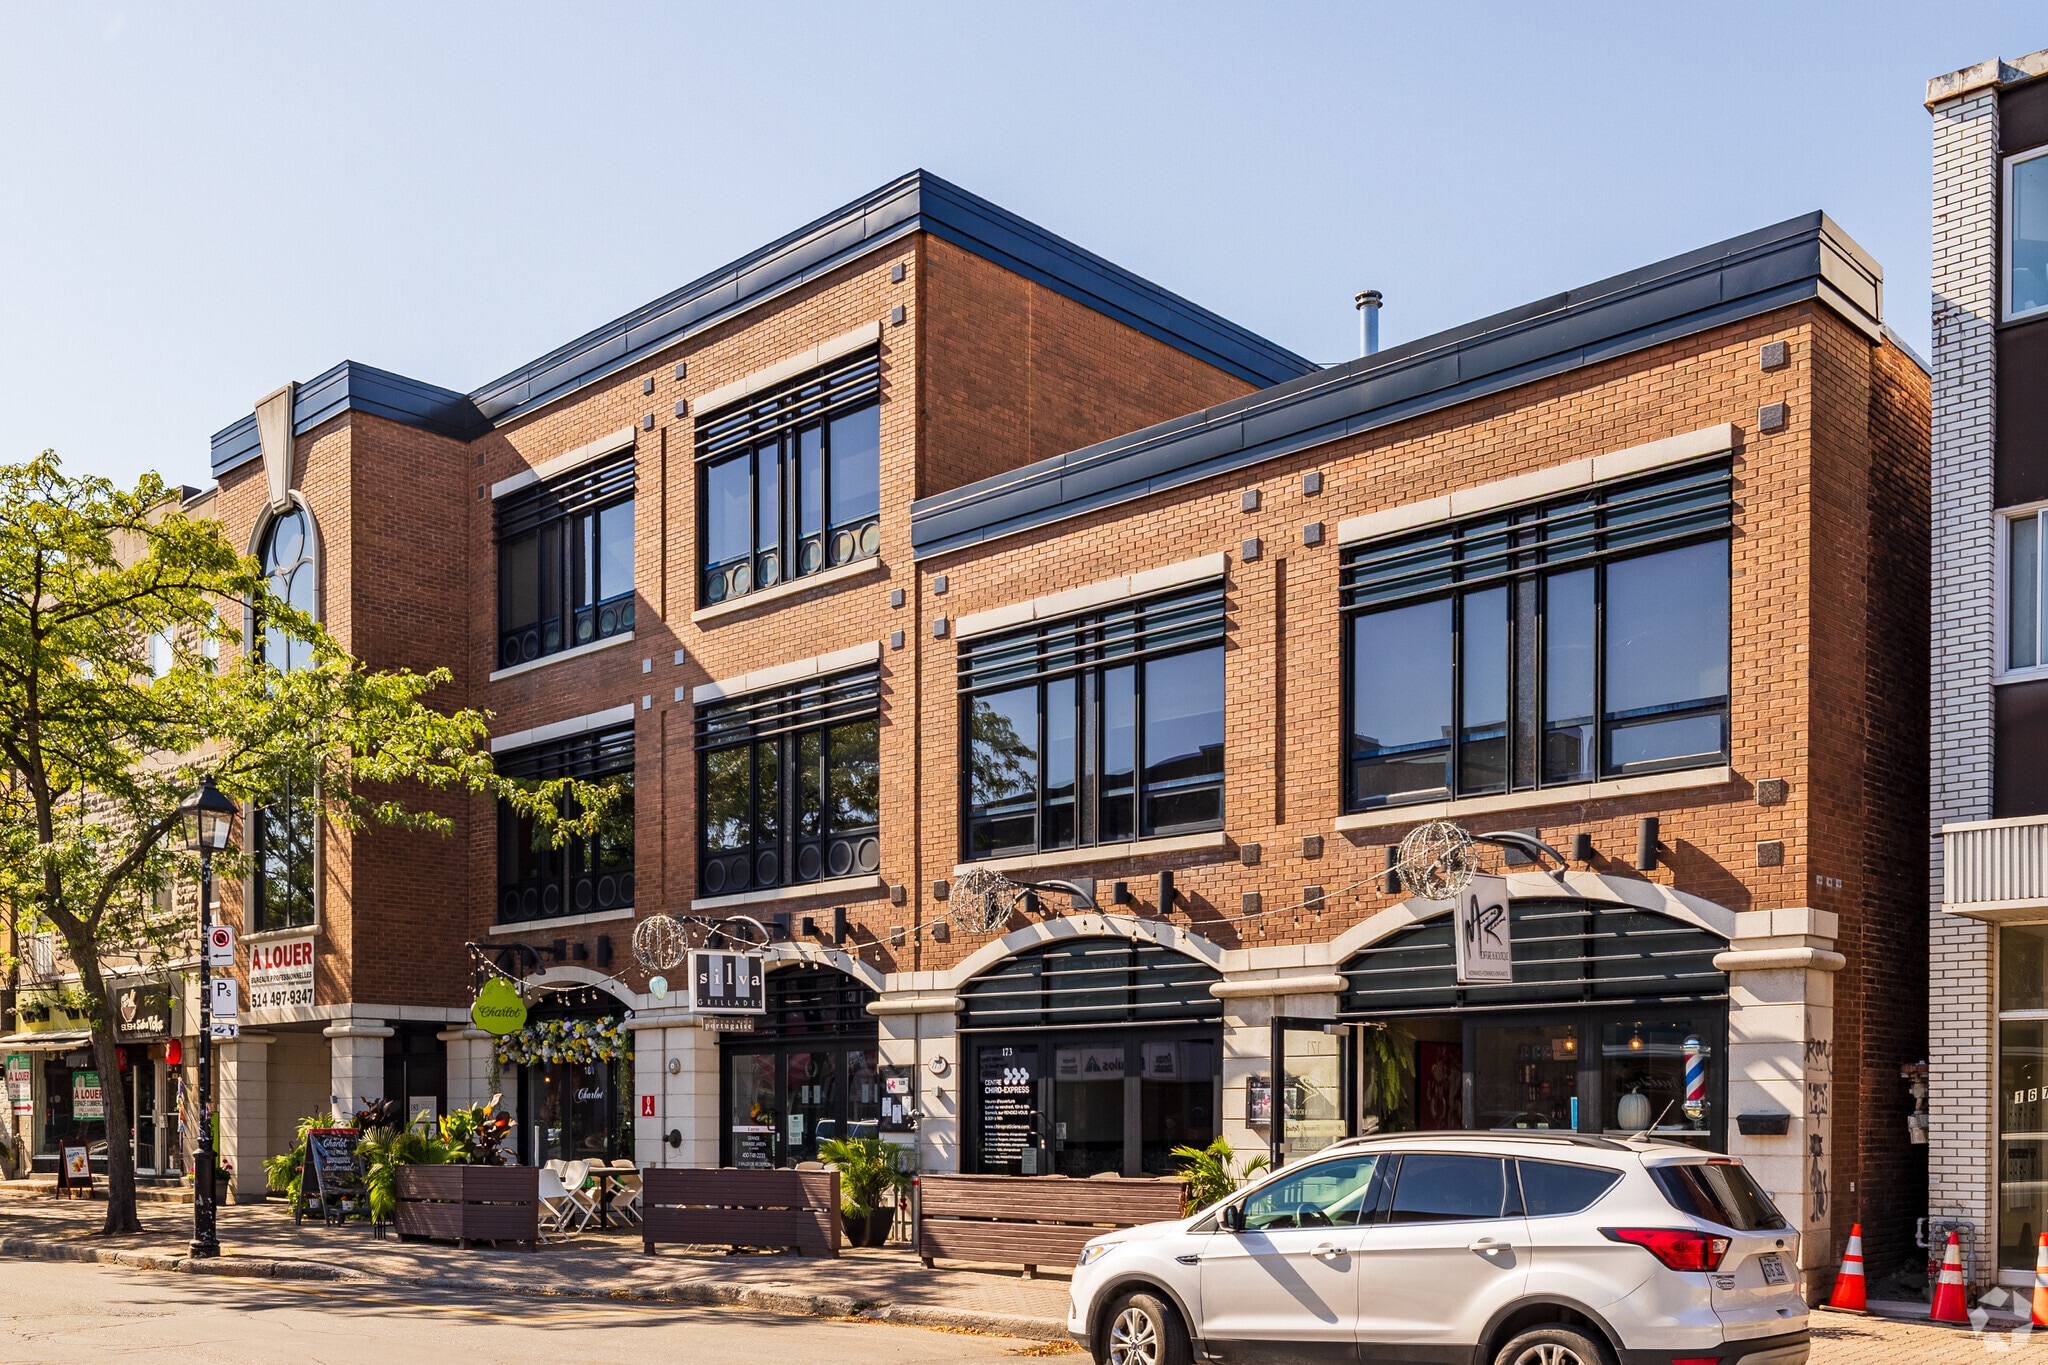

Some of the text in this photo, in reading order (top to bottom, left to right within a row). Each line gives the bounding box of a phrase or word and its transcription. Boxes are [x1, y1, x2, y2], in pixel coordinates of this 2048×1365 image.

[252, 942, 313, 971] À LOUER
[699, 962, 761, 986] silva
[252, 988, 313, 1008] 514 497-9347
[698, 999, 762, 1007] GRILLADES
[479, 1006, 521, 1018] Charlot
[704, 1022, 752, 1031] portugaise
[1002, 1047, 1013, 1056] 173
[15, 1071, 29, 1081] LOUER
[574, 1087, 603, 1103] Charlot
[985, 1086, 1030, 1094] CHIRO-EXPRESS
